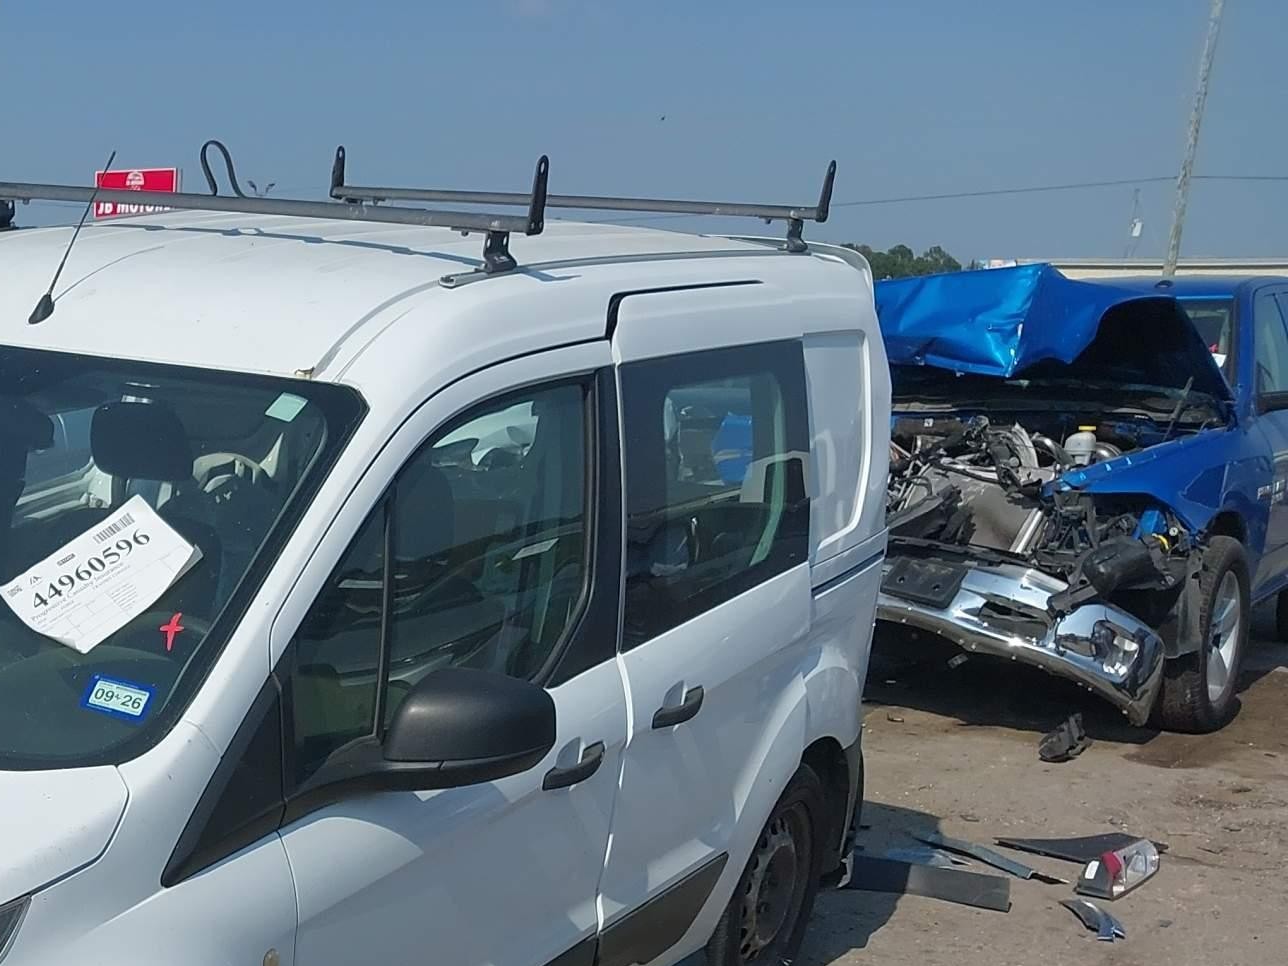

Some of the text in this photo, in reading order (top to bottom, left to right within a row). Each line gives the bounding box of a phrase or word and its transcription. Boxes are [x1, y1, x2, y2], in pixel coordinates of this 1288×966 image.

[98, 202, 113, 214] JD
[32, 528, 150, 609] 44960596
[94, 688, 142, 710] 09 26
